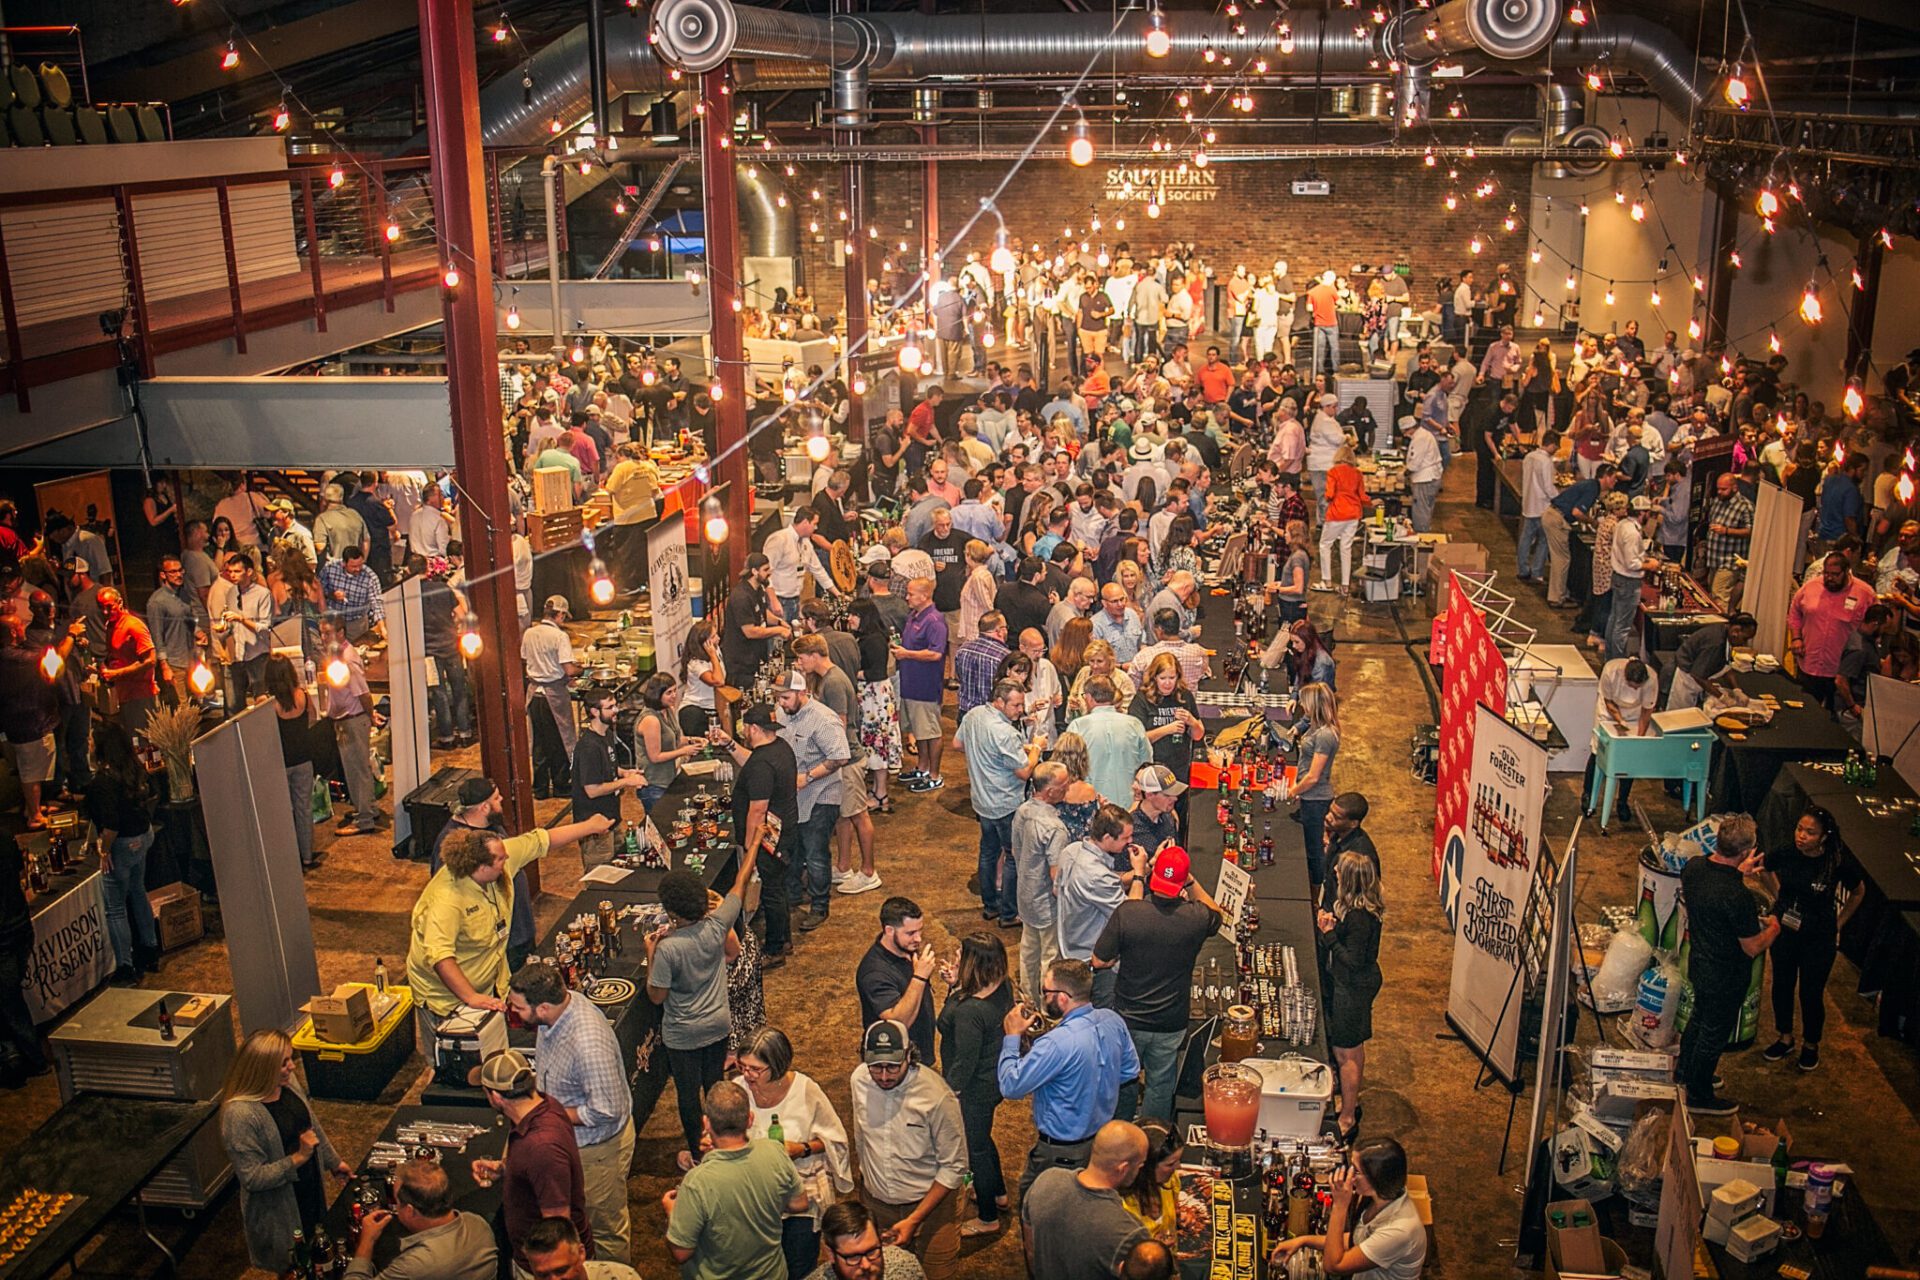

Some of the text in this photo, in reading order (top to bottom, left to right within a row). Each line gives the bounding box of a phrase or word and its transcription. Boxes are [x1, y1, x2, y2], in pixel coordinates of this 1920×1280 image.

[1106, 169, 1217, 185] SOUTHERN
[1106, 190, 1217, 201] WHISKE SOCIETY
[1489, 751, 1526, 788] FORESTER
[1501, 750, 1515, 767] OLD
[1476, 876, 1514, 919] FIRST
[1463, 902, 1517, 944] BOTTLED
[33, 930, 105, 1010] RESERVE
[1215, 1204, 1232, 1256] BUFFALO TRACE
[1236, 1241, 1253, 1268] BUFFALO
